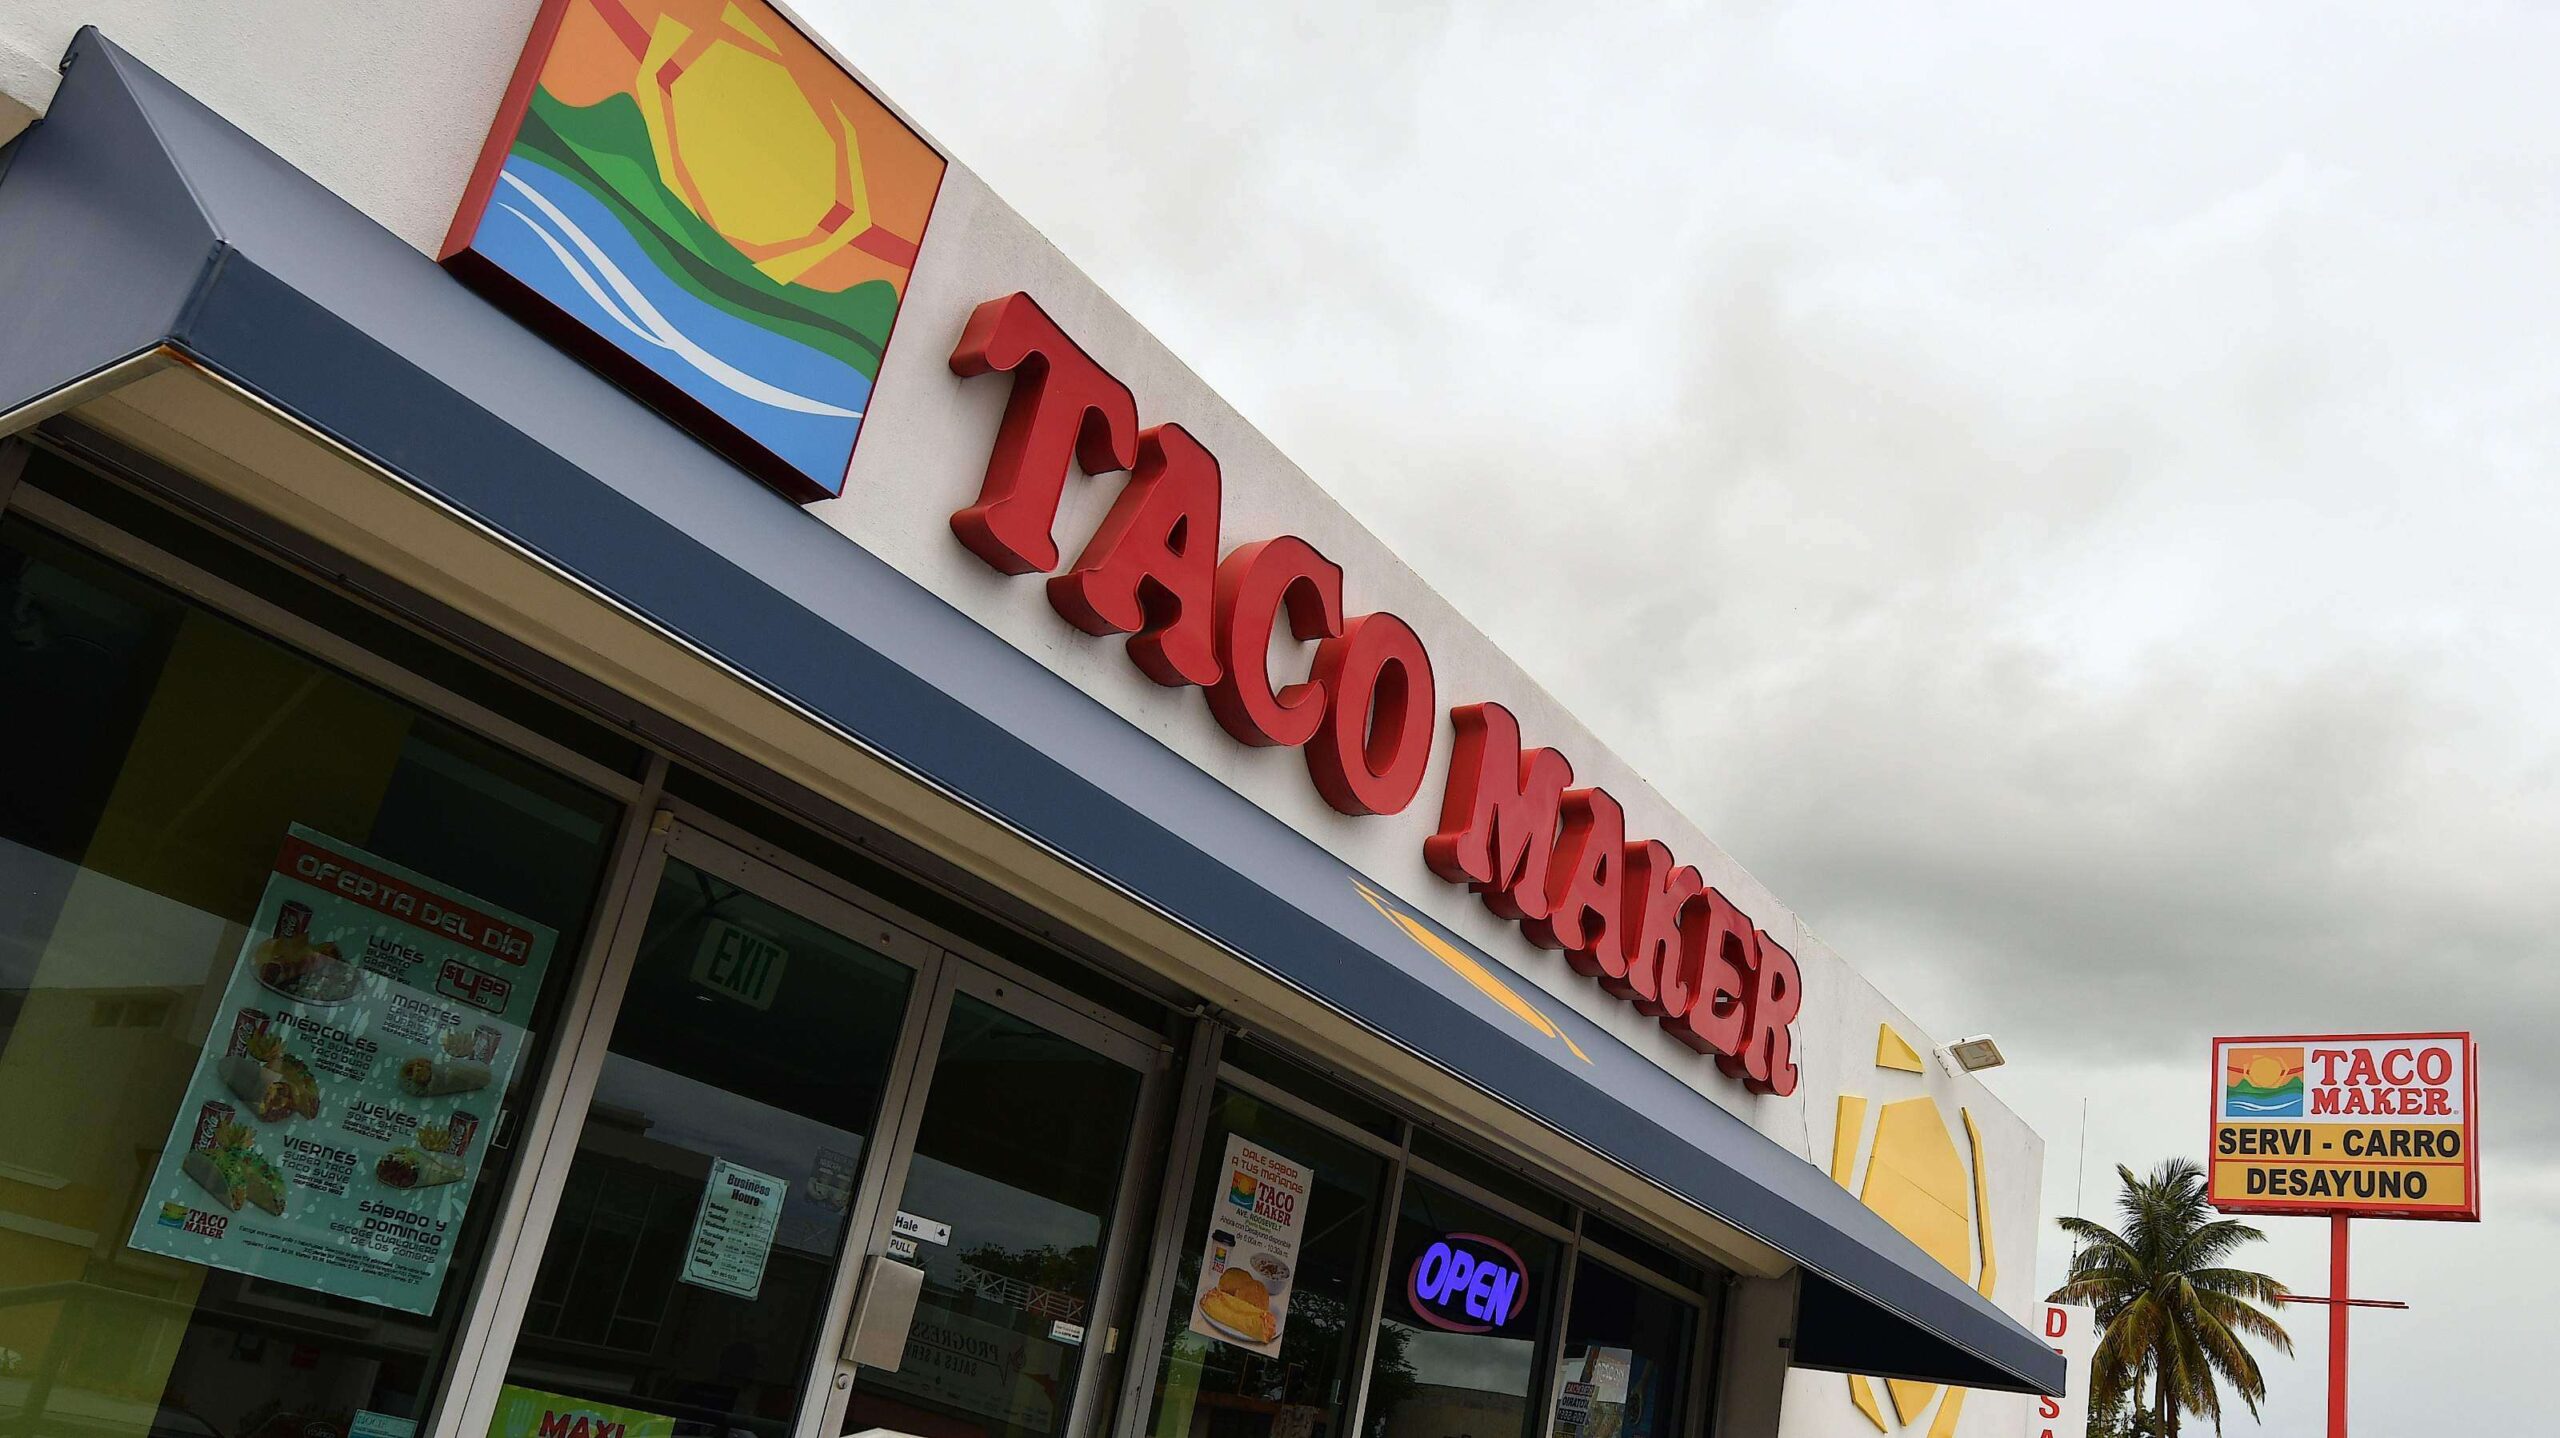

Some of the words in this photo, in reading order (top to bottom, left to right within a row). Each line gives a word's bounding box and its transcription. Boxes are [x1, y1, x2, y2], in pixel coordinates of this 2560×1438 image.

[949, 291, 1436, 816] TACO
[1423, 701, 1801, 1097] MAKER
[296, 854, 416, 917] OFERTA
[420, 903, 475, 941] DEL
[482, 927, 528, 961] DÍA
[366, 948, 410, 969] BURRITO
[369, 935, 425, 964] LUNES
[363, 956, 406, 977] GRANDE
[708, 928, 779, 1001] EXIT
[386, 1013, 429, 1034] BURRITO
[393, 994, 461, 1026] MARTES
[277, 1011, 378, 1054] MIÉRCOLES
[311, 1046, 336, 1060] TACO
[341, 1056, 370, 1070] DURO
[328, 1041, 373, 1062] BURRITO
[2311, 1047, 2452, 1086] TACO
[349, 1101, 417, 1128] JUEVES
[2310, 1087, 2452, 1116] MAKER
[347, 1111, 376, 1124] SOFT
[378, 1121, 411, 1136] SHELL
[283, 1135, 357, 1165] VIERNES
[2218, 1128, 2311, 1156] SERVI
[2342, 1129, 2460, 1158] CARRO
[282, 1159, 309, 1173] TACO
[312, 1167, 350, 1184] SUAVE
[284, 1151, 320, 1166] SUPER
[325, 1161, 353, 1176] TACO
[1231, 1156, 1239, 1167] A
[1241, 1159, 1259, 1175] TUS
[1260, 1167, 1303, 1194] MAÑANAS
[1242, 1147, 1267, 1166] DALE
[1268, 1159, 1298, 1180] SABOR
[727, 1173, 770, 1197] Business
[1258, 1181, 1294, 1213] TACO
[2247, 1168, 2427, 1199] DESAYUNO
[188, 1209, 228, 1229] TACO
[359, 1199, 430, 1228] SÁBADO
[435, 1220, 446, 1232] Y
[895, 1216, 918, 1232] Hale
[1254, 1200, 1291, 1227] MAKER
[184, 1221, 224, 1240] MAKER
[330, 1222, 373, 1239] ESCOGE
[374, 1232, 438, 1256] CUALQUIERA
[363, 1217, 441, 1246] DOMINGO
[350, 1236, 367, 1248] DE
[368, 1240, 388, 1253] LOS
[391, 1247, 435, 1264] COMBOS
[890, 1239, 912, 1254] PULL
[1416, 1242, 1520, 1326] OPEN
[539, 1410, 625, 1438] MAXI
